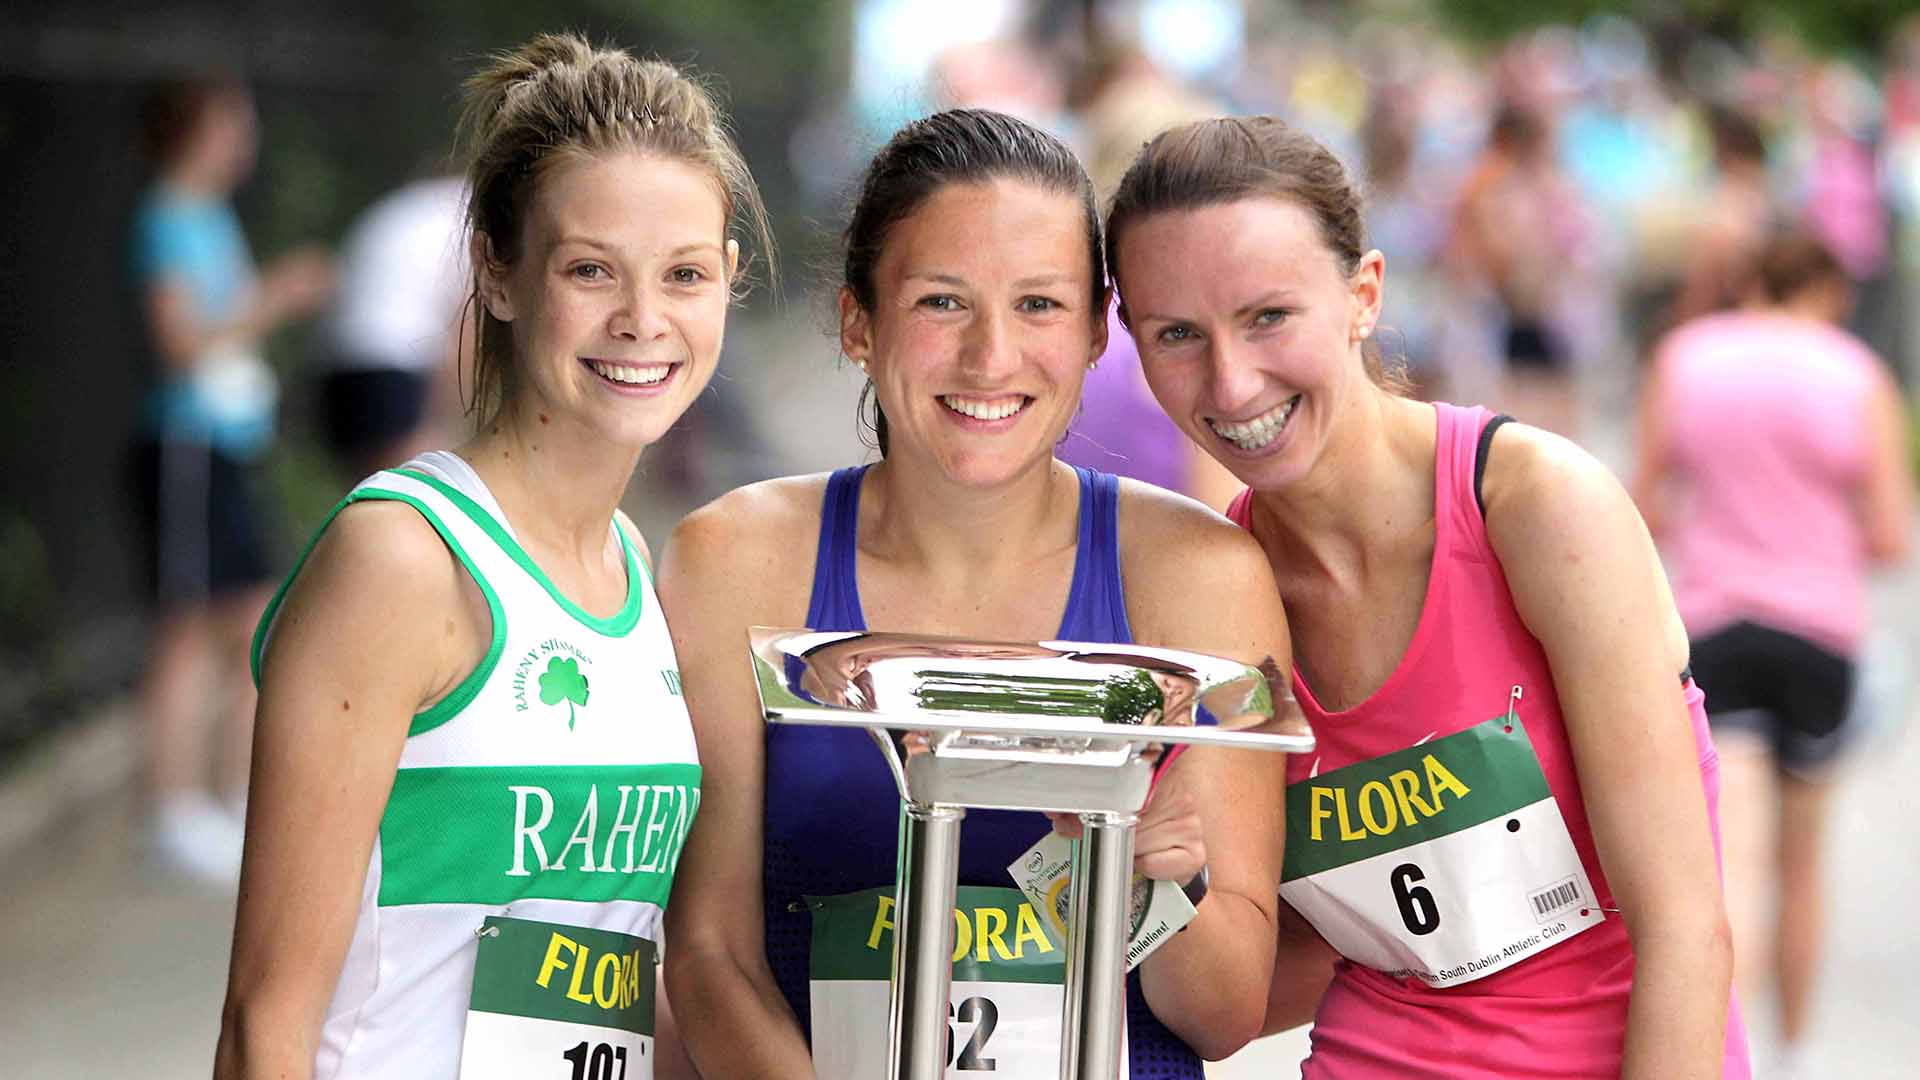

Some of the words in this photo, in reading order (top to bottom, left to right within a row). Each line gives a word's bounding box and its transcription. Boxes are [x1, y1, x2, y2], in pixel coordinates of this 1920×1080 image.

[1310, 753, 1472, 842] FLORA
[866, 895, 1055, 963] FRA
[1390, 862, 1441, 937] 6
[536, 931, 641, 1011] FLORA
[1439, 966, 1469, 981] South
[1468, 952, 1502, 974] Dublin
[1502, 935, 1542, 960] Athletic
[1541, 922, 1567, 940] Club
[947, 996, 999, 1072] 2
